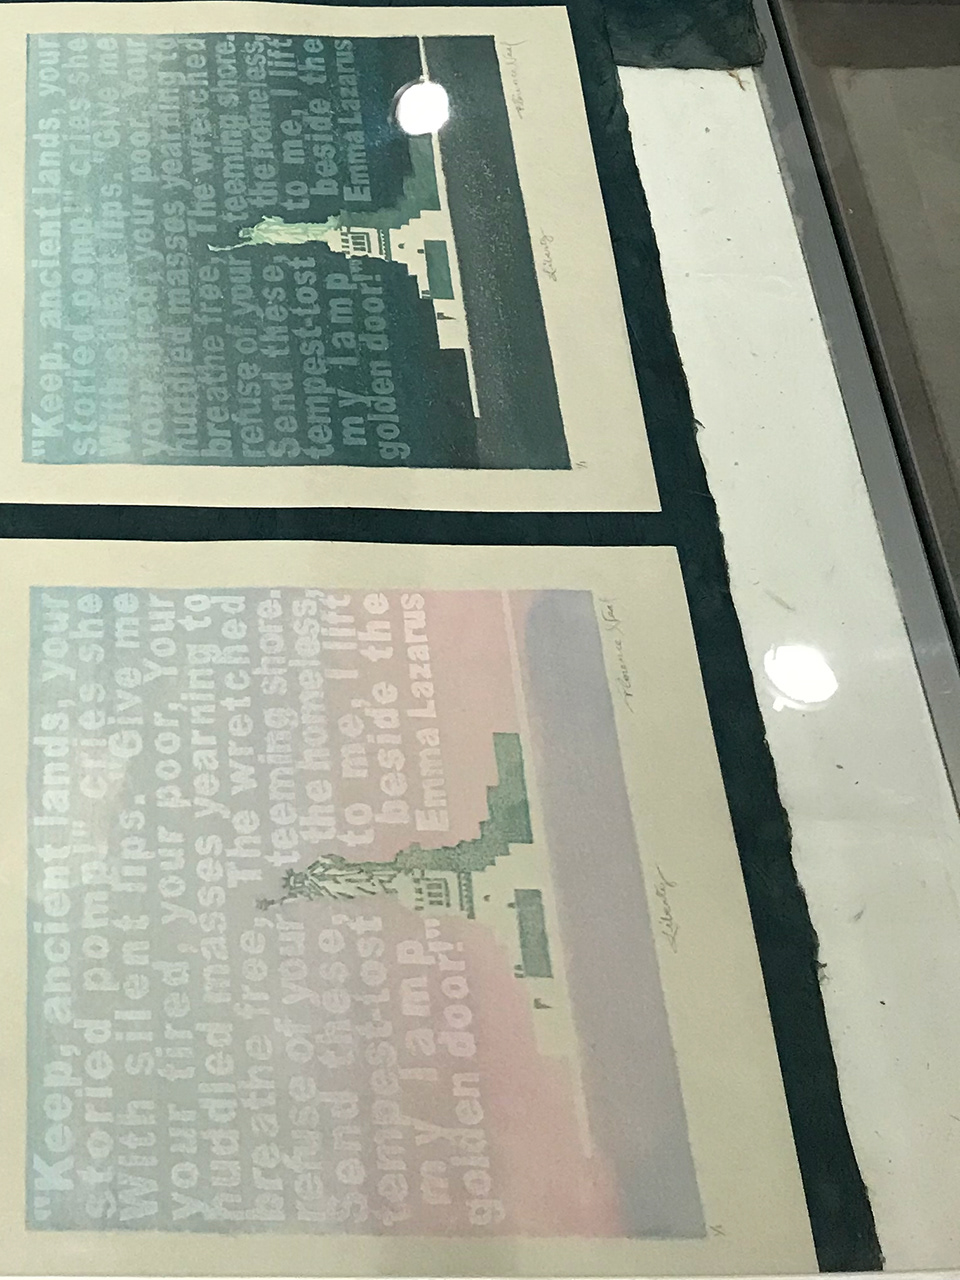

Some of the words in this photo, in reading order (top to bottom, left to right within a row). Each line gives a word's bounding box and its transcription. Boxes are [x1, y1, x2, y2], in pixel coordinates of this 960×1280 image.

[38, 36, 66, 97] your
[61, 38, 89, 84] she
[95, 37, 118, 75] me
[120, 38, 149, 99] Your
[148, 38, 178, 63] to
[210, 35, 240, 107] shore.
[241, 35, 274, 159] homeless,
[266, 38, 298, 77] lift
[296, 38, 327, 85] the
[334, 39, 362, 125] Lazarus
[32, 108, 66, 194] lands,
[62, 97, 91, 176] cries
[128, 110, 159, 182] poor,
[153, 72, 192, 190] yearning
[178, 38, 213, 174] wretched
[280, 110, 308, 164] me,
[302, 98, 339, 195] beside
[94, 173, 130, 239] lips.
[187, 184, 217, 237] The
[214, 114, 249, 223] teeming
[247, 163, 277, 208] the
[280, 181, 310, 211] to
[343, 131, 372, 201] Emma
[31, 207, 61, 328] ancient
[132, 194, 164, 261] your
[162, 201, 191, 314] masses
[94, 253, 132, 362] silent
[193, 257, 226, 325] free,
[227, 254, 264, 317] your
[259, 256, 290, 358] these,
[324, 273, 360, 366] lamp
[348, 260, 389, 350] door!"
[225, 324, 258, 354] of
[31, 342, 70, 457] "Keep,
[64, 324, 97, 456] storied
[98, 379, 131, 457] With
[140, 379, 168, 457] your
[162, 327, 199, 456] huddled
[196, 335, 233, 458] breathe
[231, 362, 266, 458] refuse
[262, 373, 301, 459] Send
[338, 389, 371, 446] my
[366, 360, 411, 460] golden
[40, 593, 76, 682] your
[70, 593, 104, 664] she
[113, 592, 140, 648] me
[143, 592, 178, 683] Your
[178, 594, 211, 631] to
[251, 590, 287, 695] shore.
[322, 595, 357, 650] lift
[357, 593, 393, 662] the
[399, 593, 436, 718] Lazarus
[211, 596, 257, 795] wretched
[288, 590, 331, 770] homeless,
[324, 669, 358, 678] I
[33, 699, 76, 826] lands,
[72, 683, 108, 799] cries
[153, 702, 191, 808] poor,
[180, 644, 230, 818] yearning
[338, 698, 371, 778] me,
[364, 681, 409, 824] beside
[257, 707, 298, 867] teeming
[299, 780, 336, 842] the
[337, 803, 374, 847] to
[414, 728, 450, 831] Emma
[111, 795, 155, 893] lips.
[157, 826, 197, 924] your
[225, 810, 261, 888] The
[32, 844, 72, 1024] ancient
[195, 835, 231, 1003] masses
[276, 914, 319, 1005] your
[111, 915, 154, 1076] silent
[233, 918, 273, 1019] free,
[315, 914, 354, 1069] these,
[396, 940, 438, 1081] lamp
[424, 919, 476, 1057] door!"
[274, 1017, 314, 1064] of
[33, 1045, 82, 1221] "Keep,
[73, 1019, 116, 1219] storied
[117, 1100, 158, 1221] With
[167, 1103, 207, 1221] your
[196, 1022, 241, 1221] huddled
[237, 1034, 285, 1221] breathe
[282, 1076, 327, 1221] refuse
[317, 1091, 368, 1223] Send
[413, 1117, 451, 1204] my
[443, 1073, 505, 1226] golden
